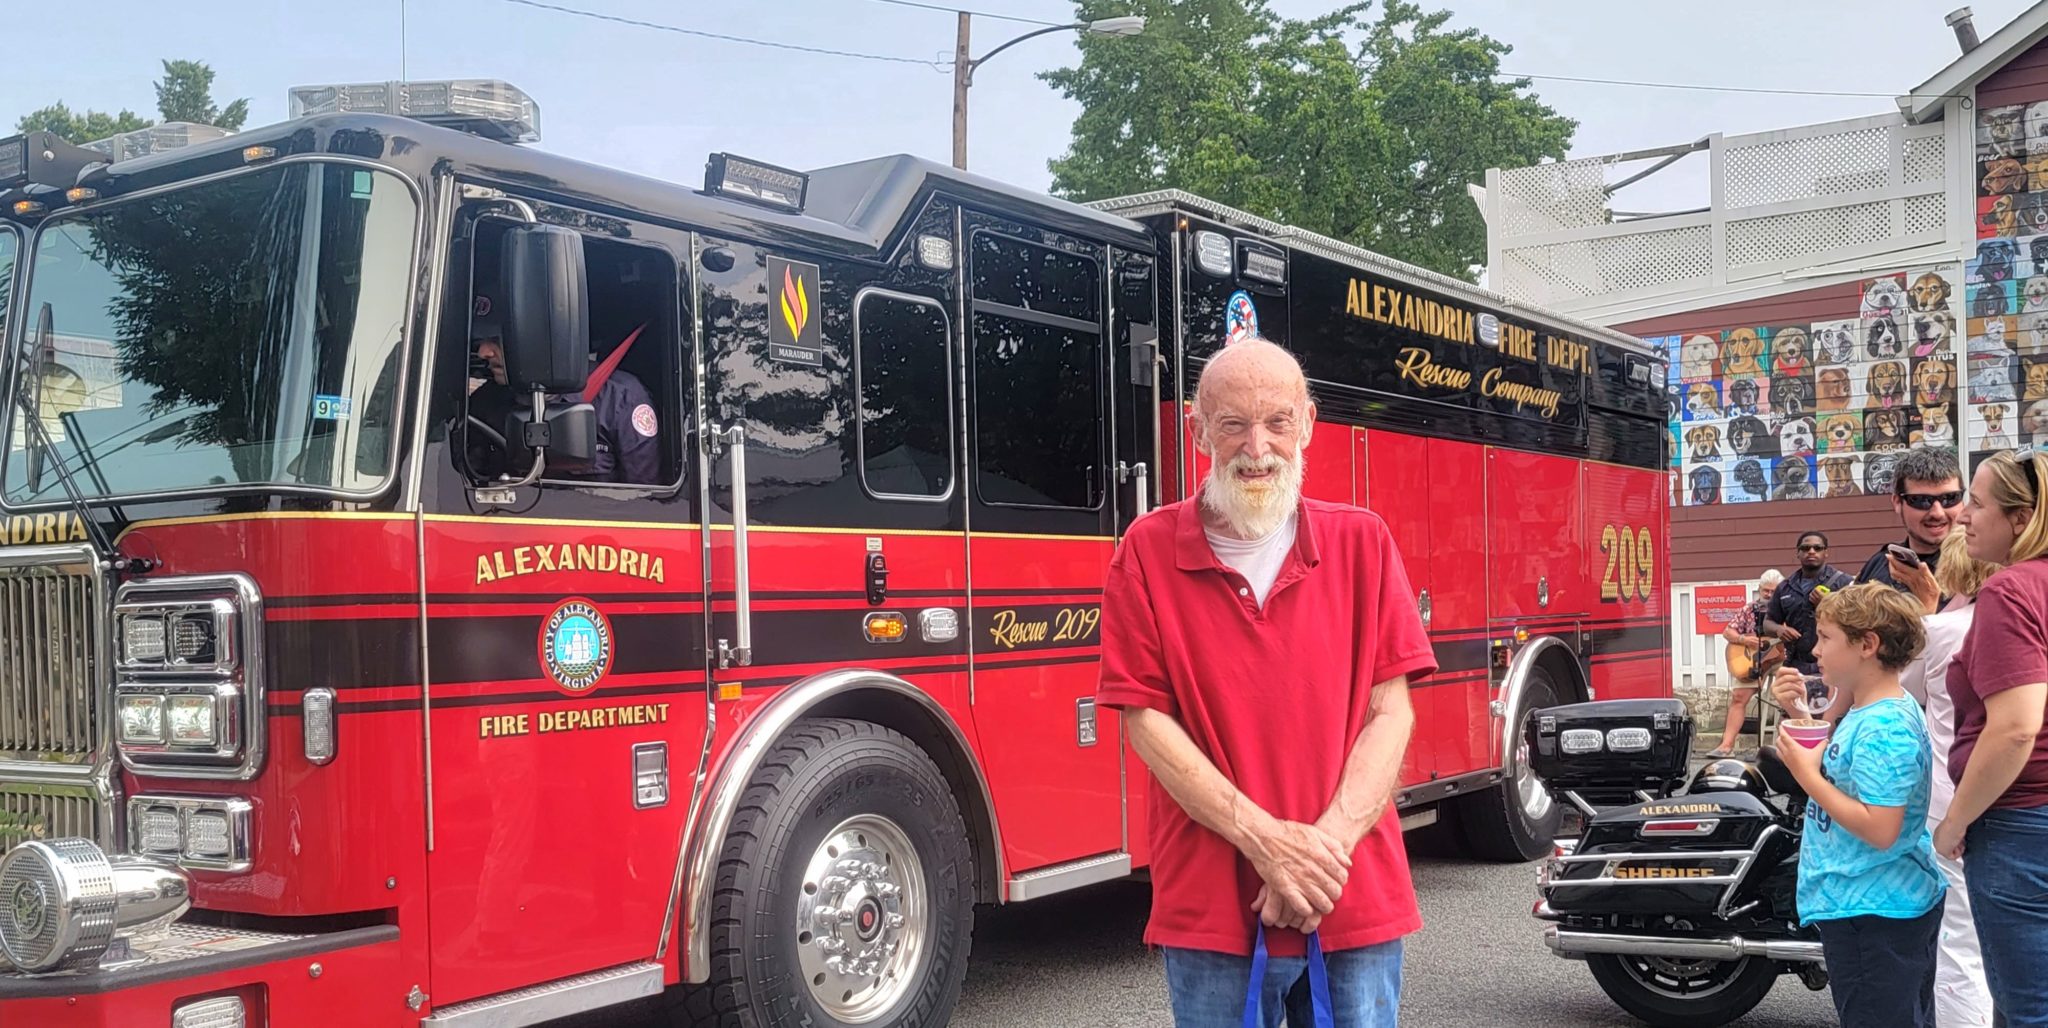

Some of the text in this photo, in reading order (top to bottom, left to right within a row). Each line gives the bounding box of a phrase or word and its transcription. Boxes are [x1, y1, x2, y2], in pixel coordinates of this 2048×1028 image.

[1346, 278, 1592, 374] ALEXANDRIA FIRE DEPT.
[778, 348, 814, 360] MARAUDER
[1395, 347, 1562, 418] Rescue Company
[319, 401, 328, 415] 9
[1875, 443, 1906, 451] COCO
[476, 543, 665, 585] ALEXANDRIA
[1600, 524, 1654, 603] 209
[545, 604, 609, 662] CITY OF ALEXANDRIA
[990, 608, 1100, 649] Rescue 209
[552, 665, 604, 688] VIRGINIA
[480, 703, 670, 738] FIRE DEPARTMENT
[1639, 803, 1722, 816] ALEXANDRIA
